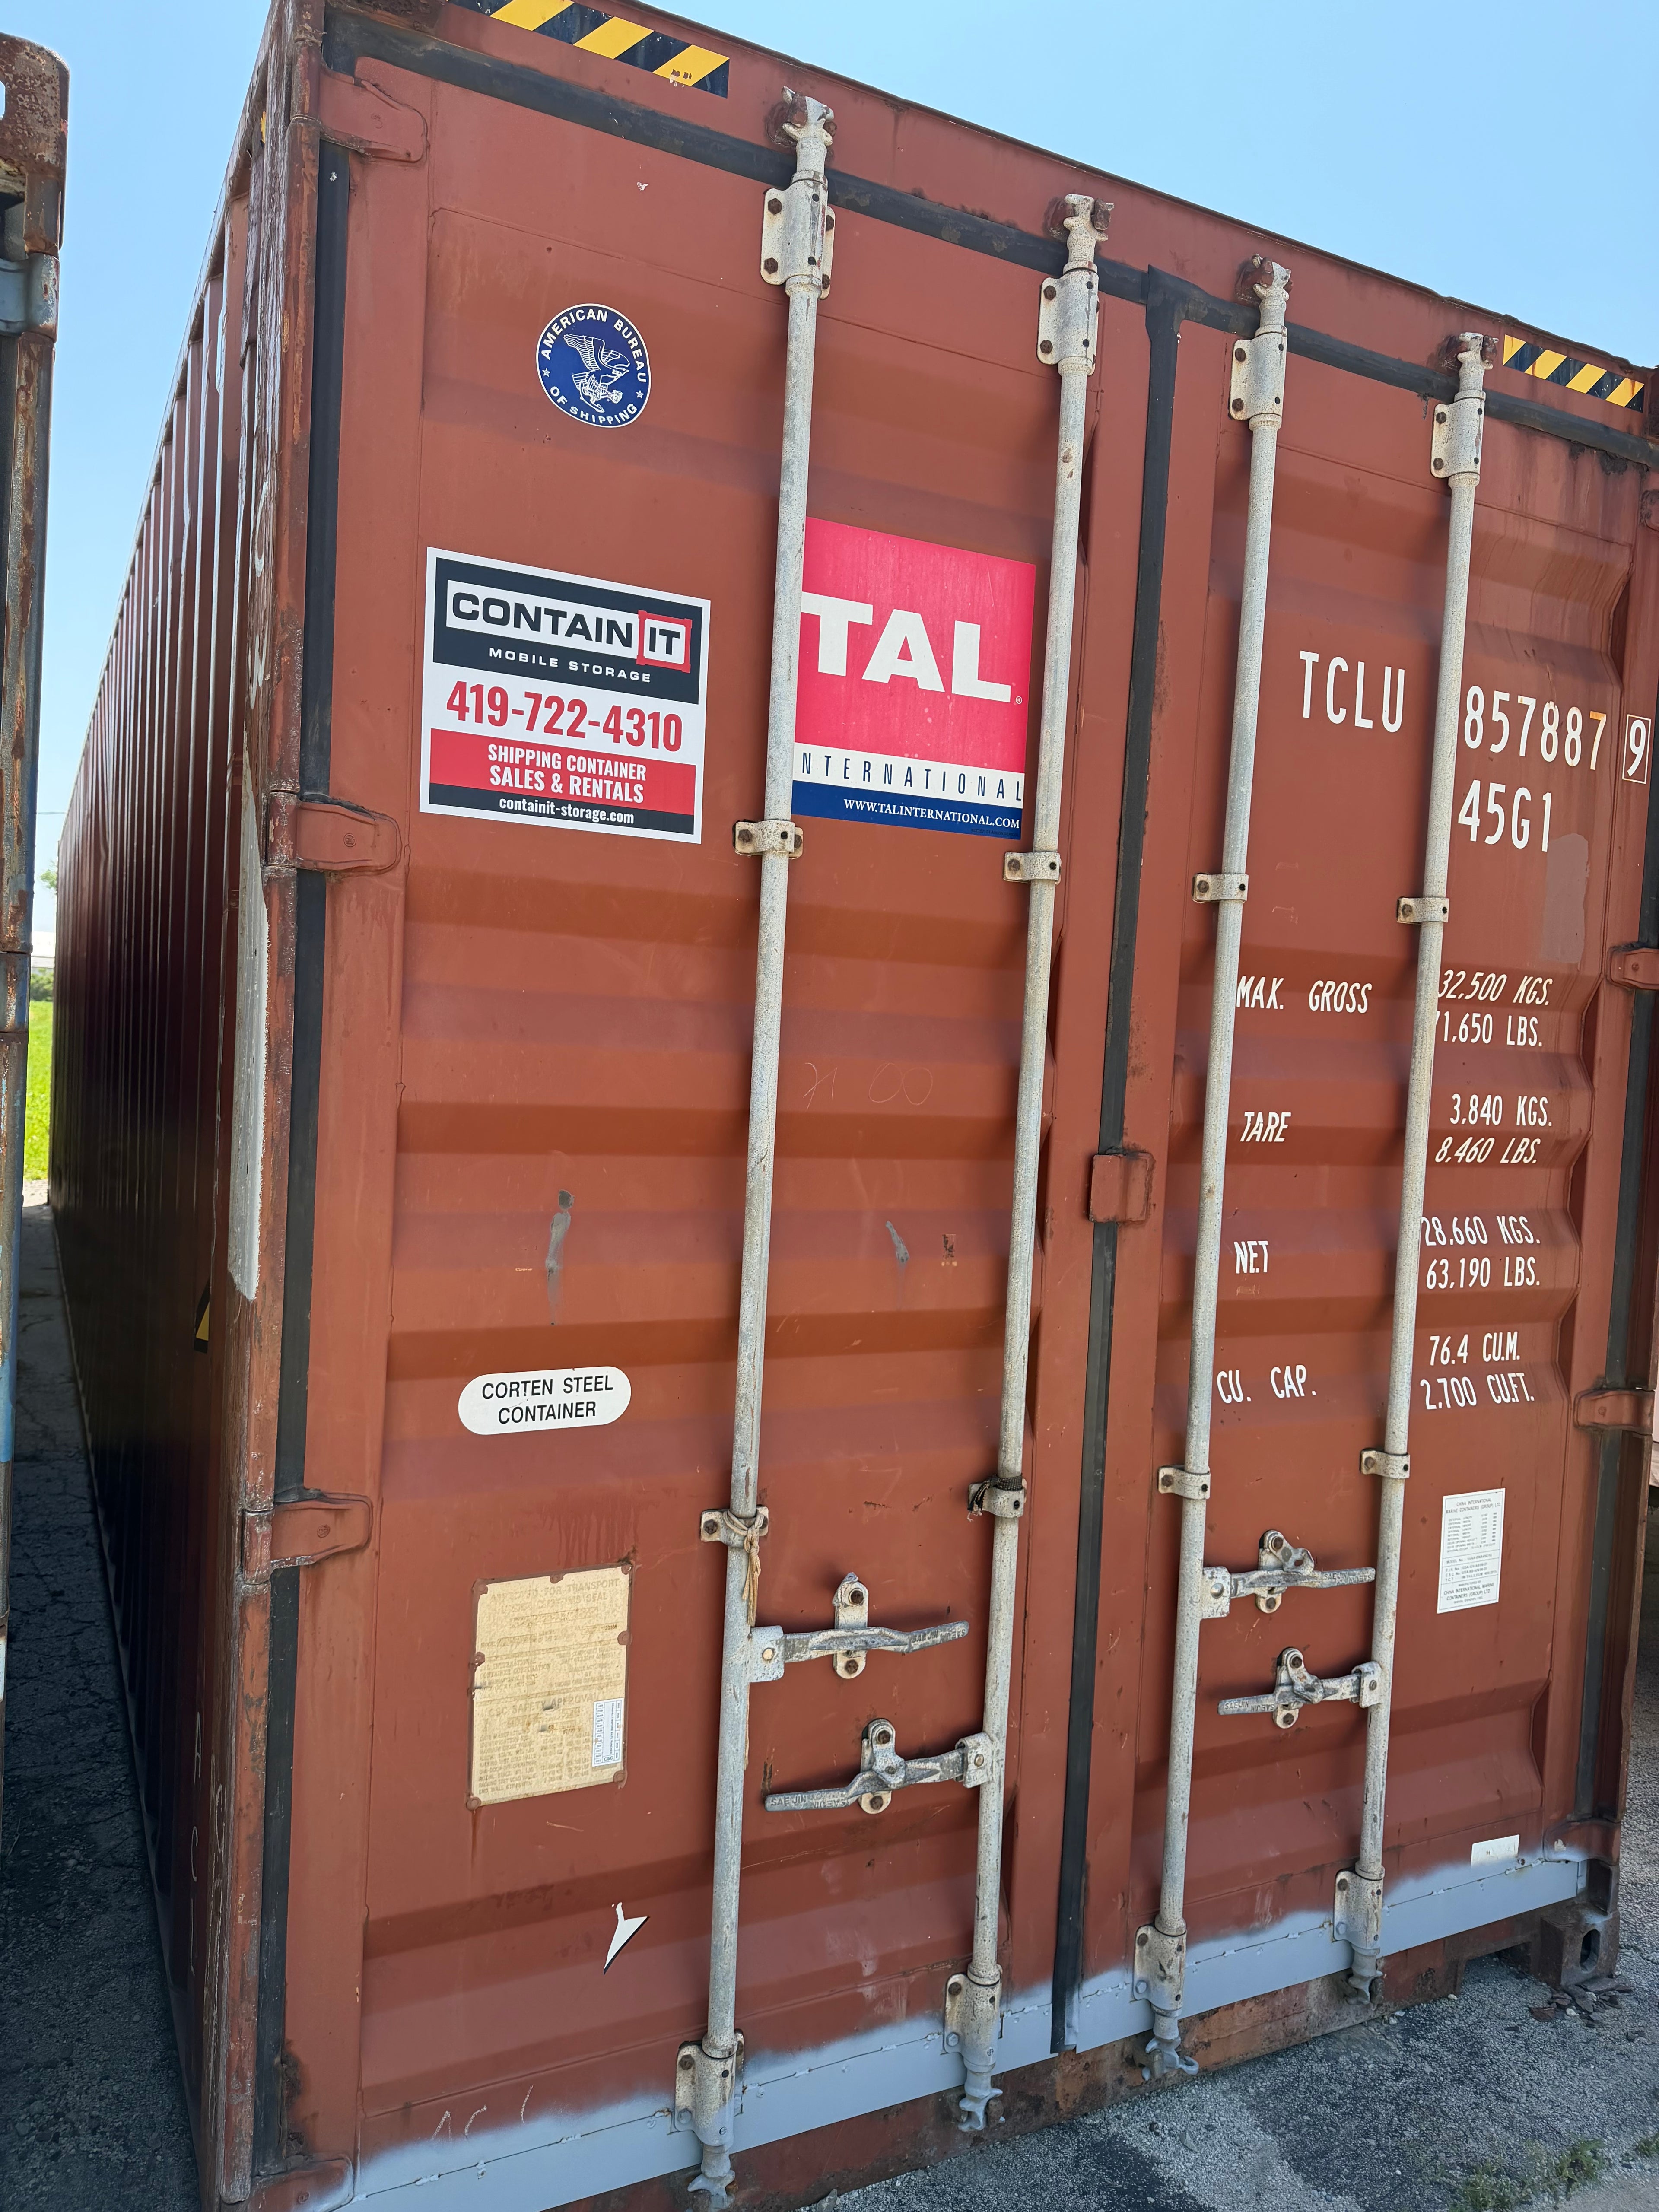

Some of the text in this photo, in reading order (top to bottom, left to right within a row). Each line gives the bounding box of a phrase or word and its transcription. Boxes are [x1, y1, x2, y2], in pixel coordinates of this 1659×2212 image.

[541, 308, 647, 383] AMERICAN BUREAU
[550, 386, 637, 424] OF SHIPPING
[801, 591, 1011, 703] TAL
[489, 648, 651, 683] MOBILE STORAGE
[447, 680, 683, 752] 419-722-4310
[1300, 650, 1646, 777] TCLU 857887 9
[488, 744, 647, 781] SHIPPING CONTAINER
[802, 752, 1022, 801] NTERNATIONAL
[490, 764, 644, 804] SALES & RENTALS
[499, 797, 635, 824] containit-storage.com
[843, 798, 1020, 829] WWW.TALINTERNATIONAL.COM
[1458, 779, 1552, 852] 45G1
[1236, 976, 1372, 1013] MAX. GROSS
[1438, 969, 1553, 1005] 32,500 KGS.
[1506, 1015, 1542, 1047] LBS.
[1240, 1112, 1291, 1142] TARE
[1450, 1093, 1552, 1126] 3,840 KGS.
[1435, 1136, 1541, 1163] 8,460 LBS.
[1496, 1216, 1541, 1244] KGS.
[1427, 1256, 1540, 1289] 63,190 LBS.
[1430, 1334, 1468, 1366] 76.4
[482, 1375, 613, 1400] CORTEN STEEL
[1217, 1365, 1316, 1403] CU. CAP.
[498, 1401, 596, 1424] CONTAINER
[551, 1693, 593, 1707] APPROVA
